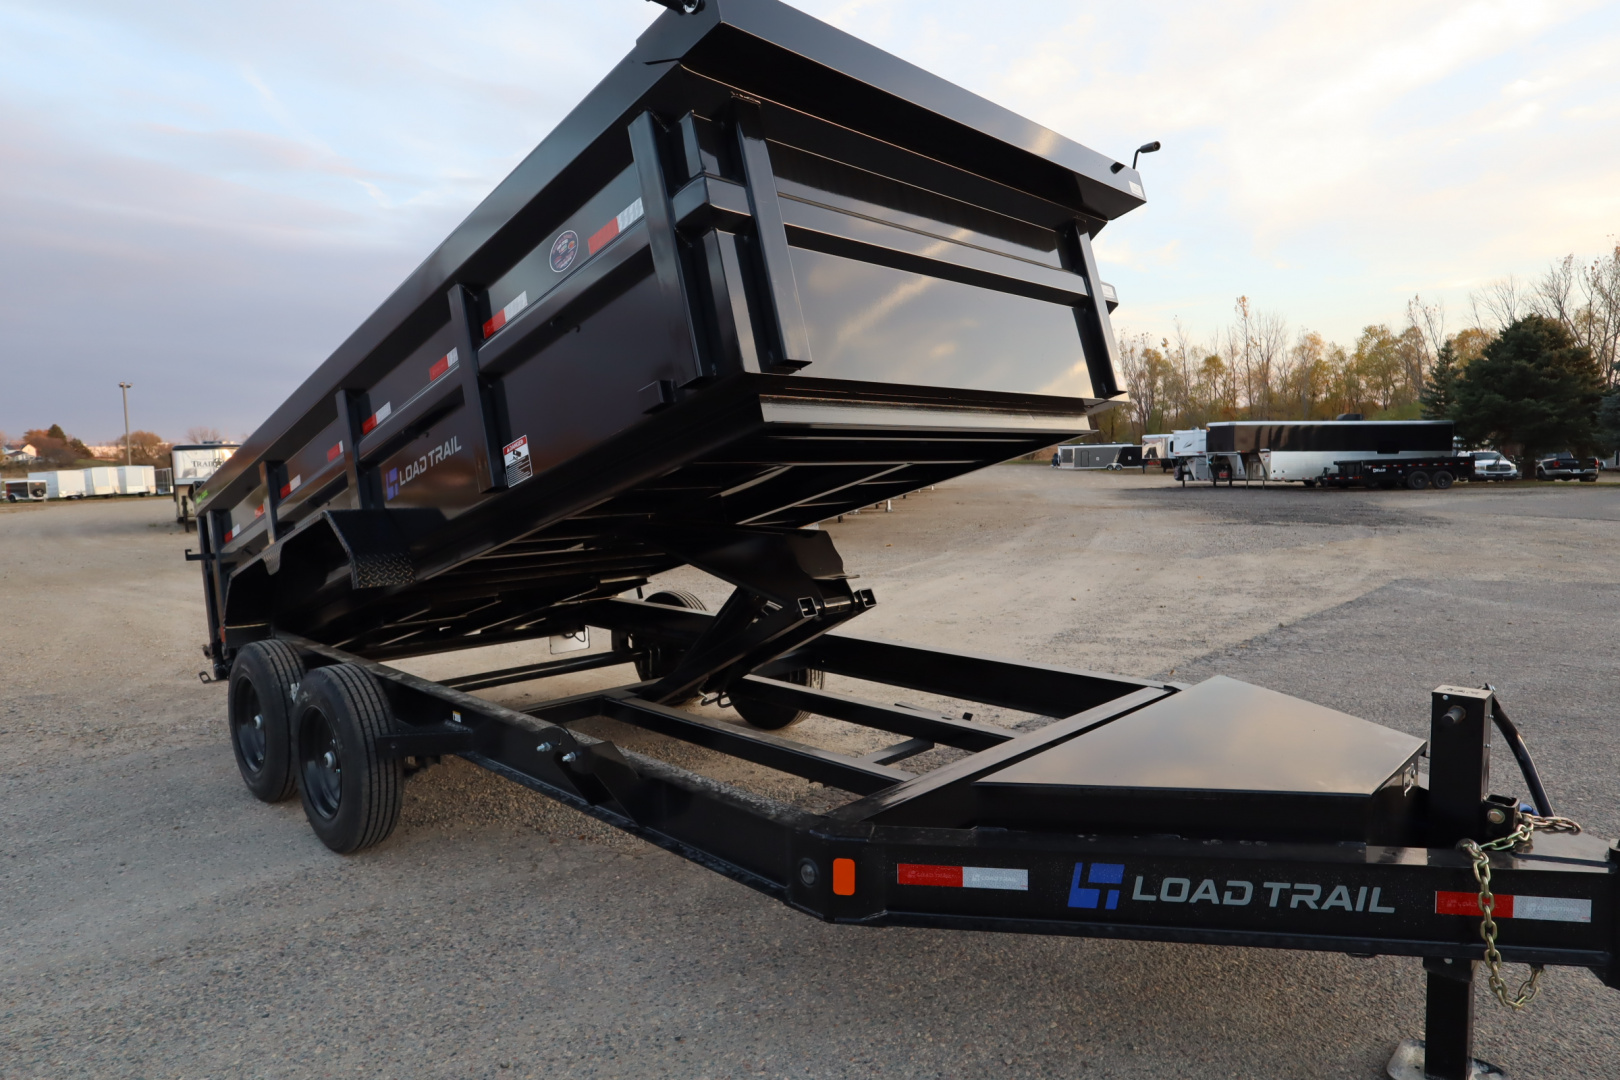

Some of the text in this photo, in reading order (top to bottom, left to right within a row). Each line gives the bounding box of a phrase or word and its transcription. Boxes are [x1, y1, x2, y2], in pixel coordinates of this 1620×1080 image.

[400, 436, 462, 486] LOAD TRAIL
[1132, 876, 1395, 913] LOAD TRAIL
